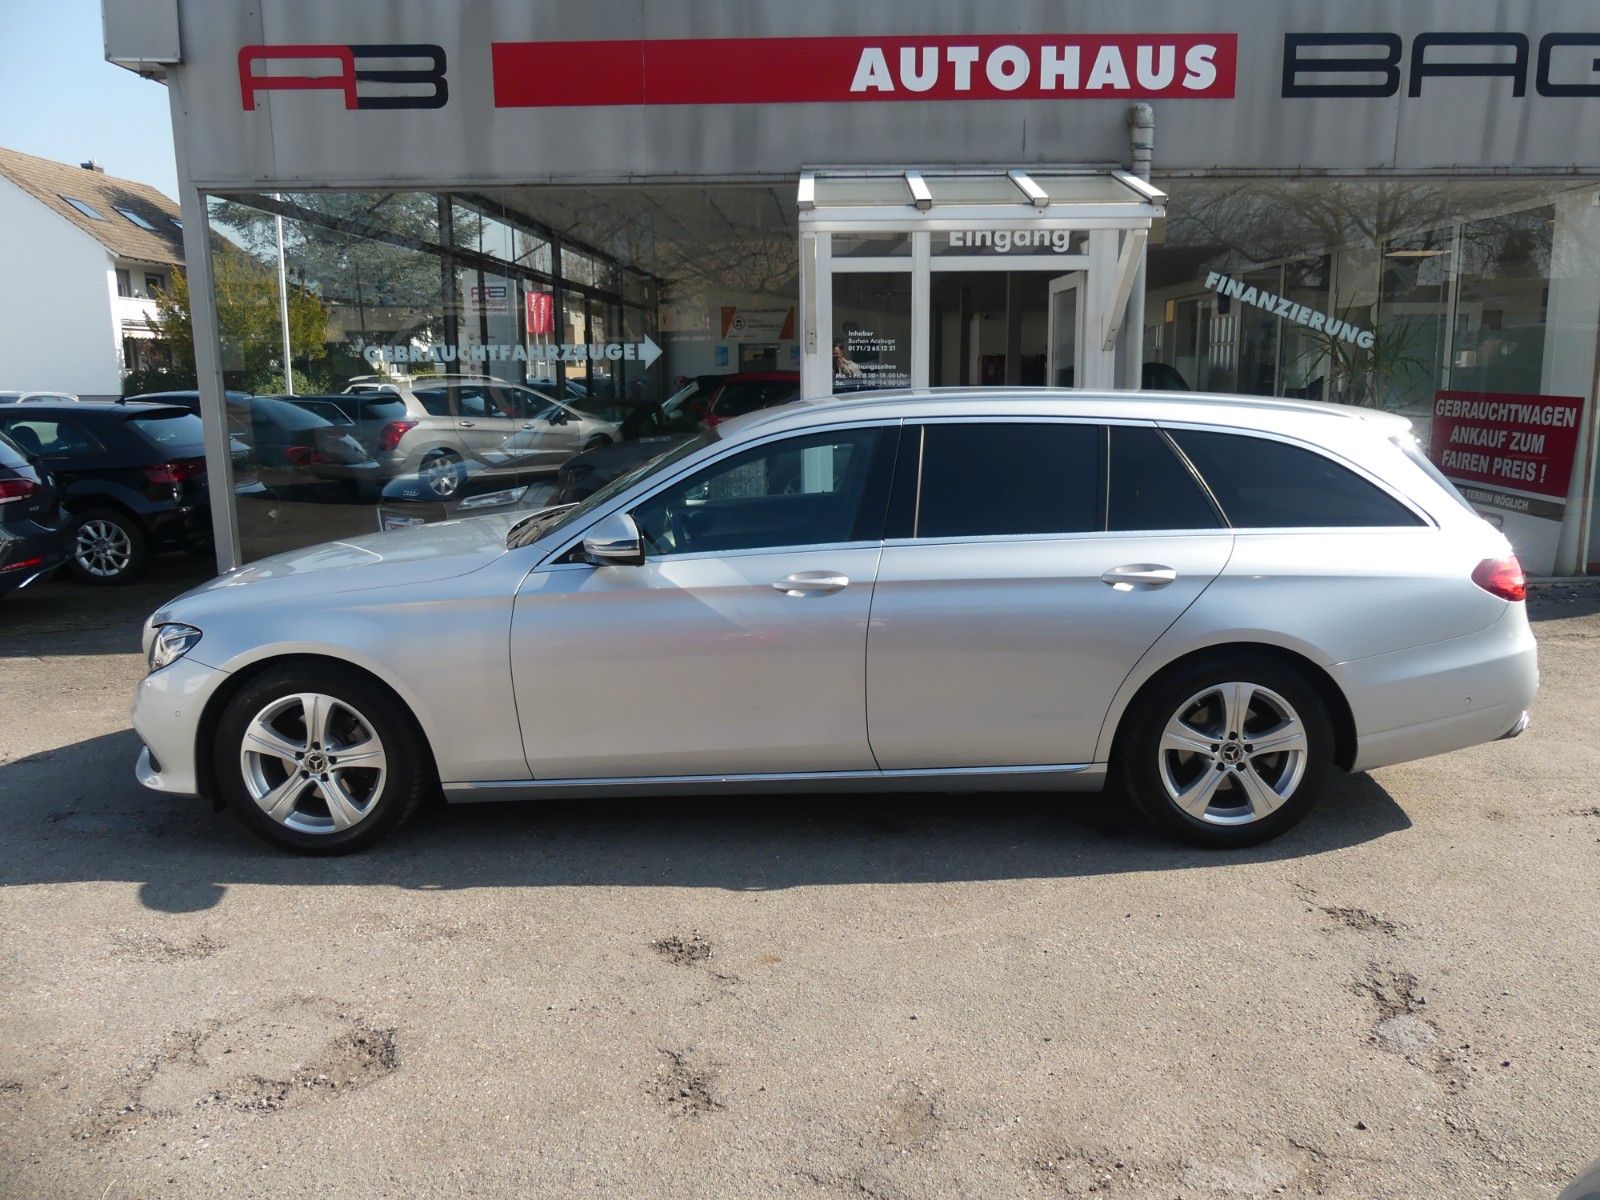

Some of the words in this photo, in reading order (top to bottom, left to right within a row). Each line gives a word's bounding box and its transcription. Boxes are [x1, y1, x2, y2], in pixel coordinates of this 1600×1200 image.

[238, 44, 449, 111] AB
[849, 44, 1217, 92] AUTOHAUS
[949, 230, 1070, 252] Eingang
[1204, 271, 1375, 349] FINANZIERUNG
[363, 344, 636, 361] GEBRAUCHTFAHRZEUGE
[1435, 400, 1577, 428] GEBRAUCHTWAGEN
[1450, 426, 1507, 449] ANKAUF
[1509, 432, 1545, 454] ZUM
[1442, 450, 1489, 474] FAIREN
[1492, 457, 1536, 482] PREIS
[1466, 489, 1493, 503] TERMIN
[1494, 493, 1529, 511] MÖGLICH
